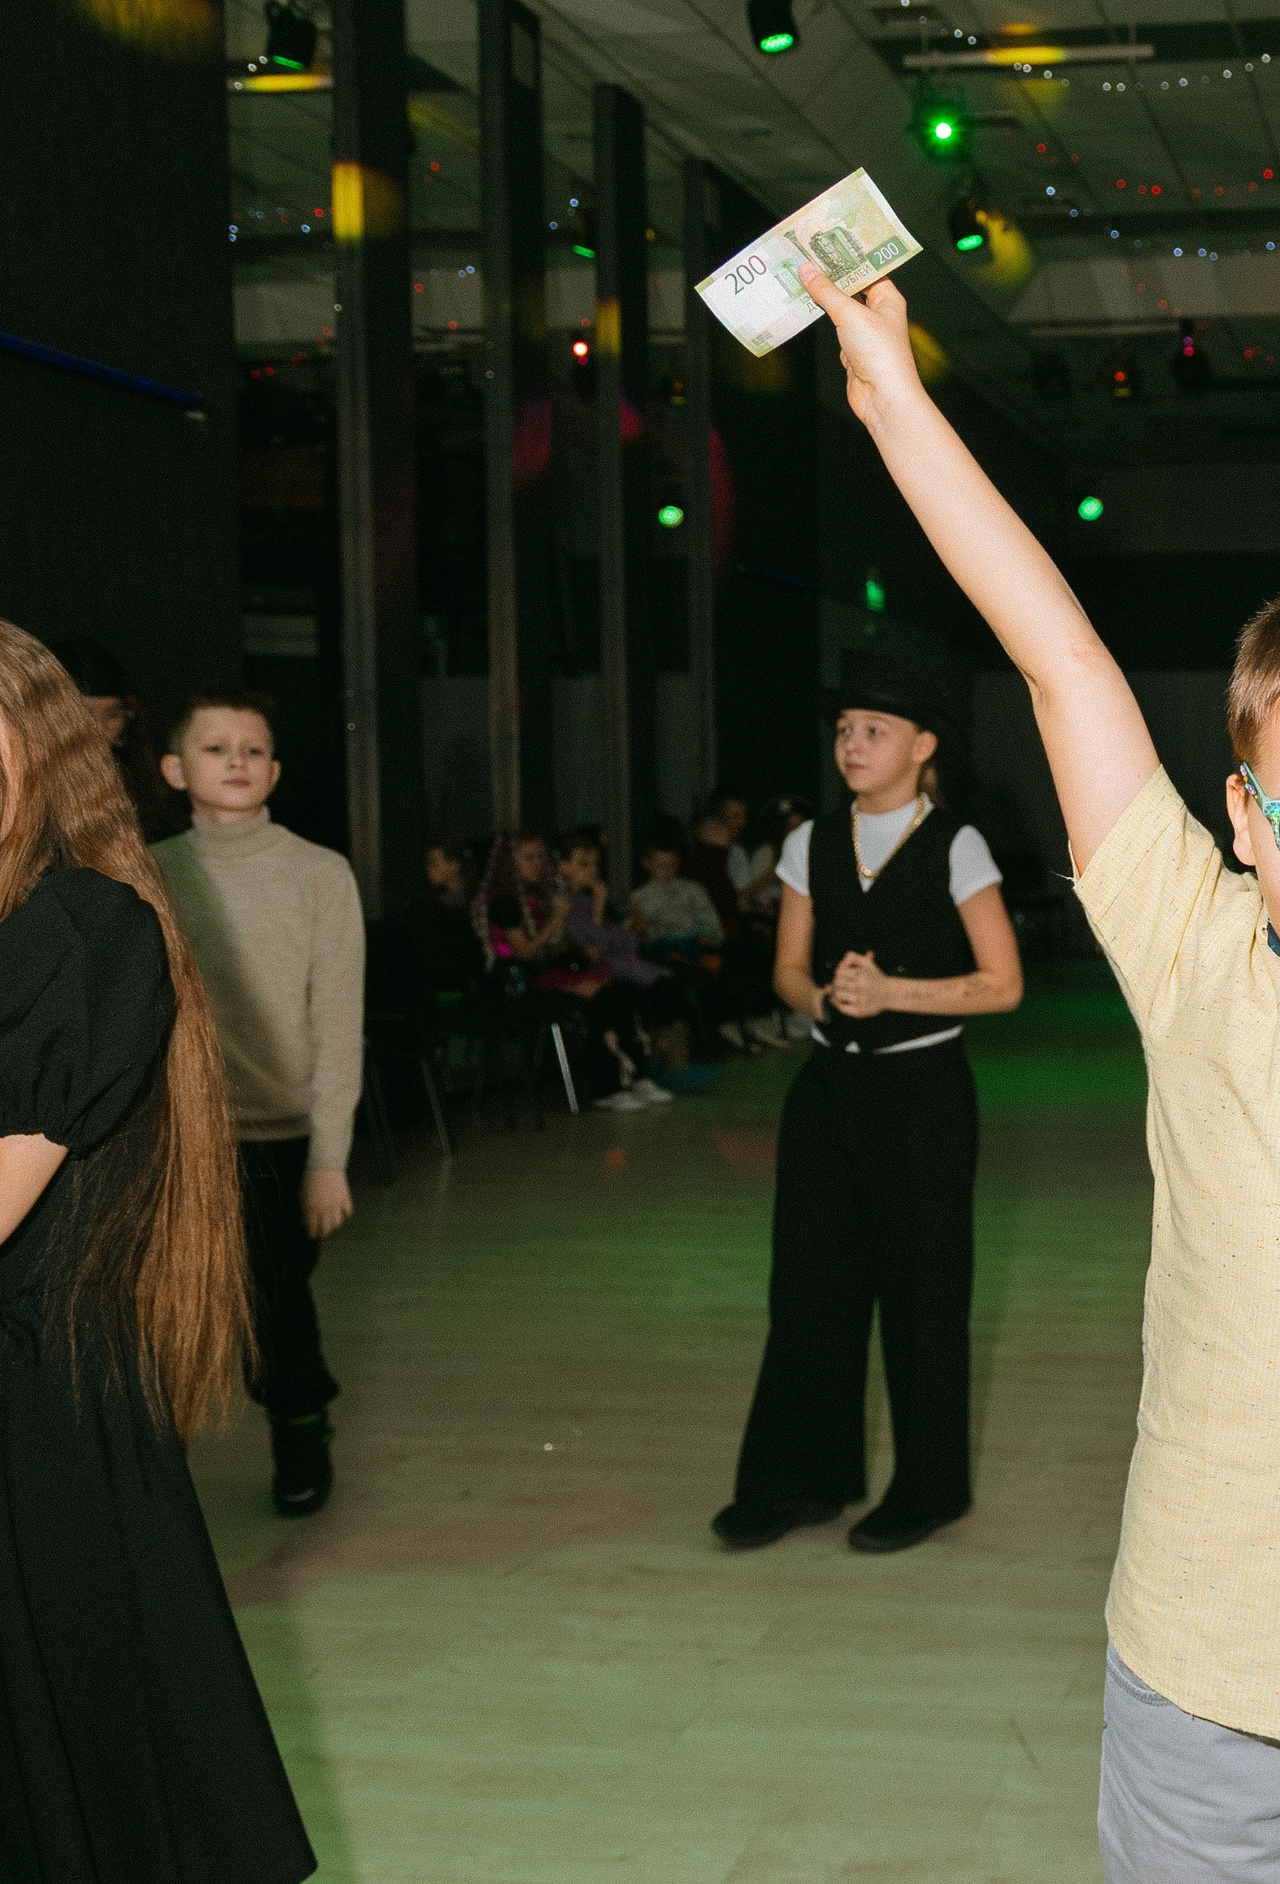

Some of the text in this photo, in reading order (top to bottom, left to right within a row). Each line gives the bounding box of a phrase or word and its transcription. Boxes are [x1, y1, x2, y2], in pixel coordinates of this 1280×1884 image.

[873, 242, 899, 266] 200
[724, 254, 768, 296] 200
[839, 262, 874, 291] ДУБЛЕЙ
